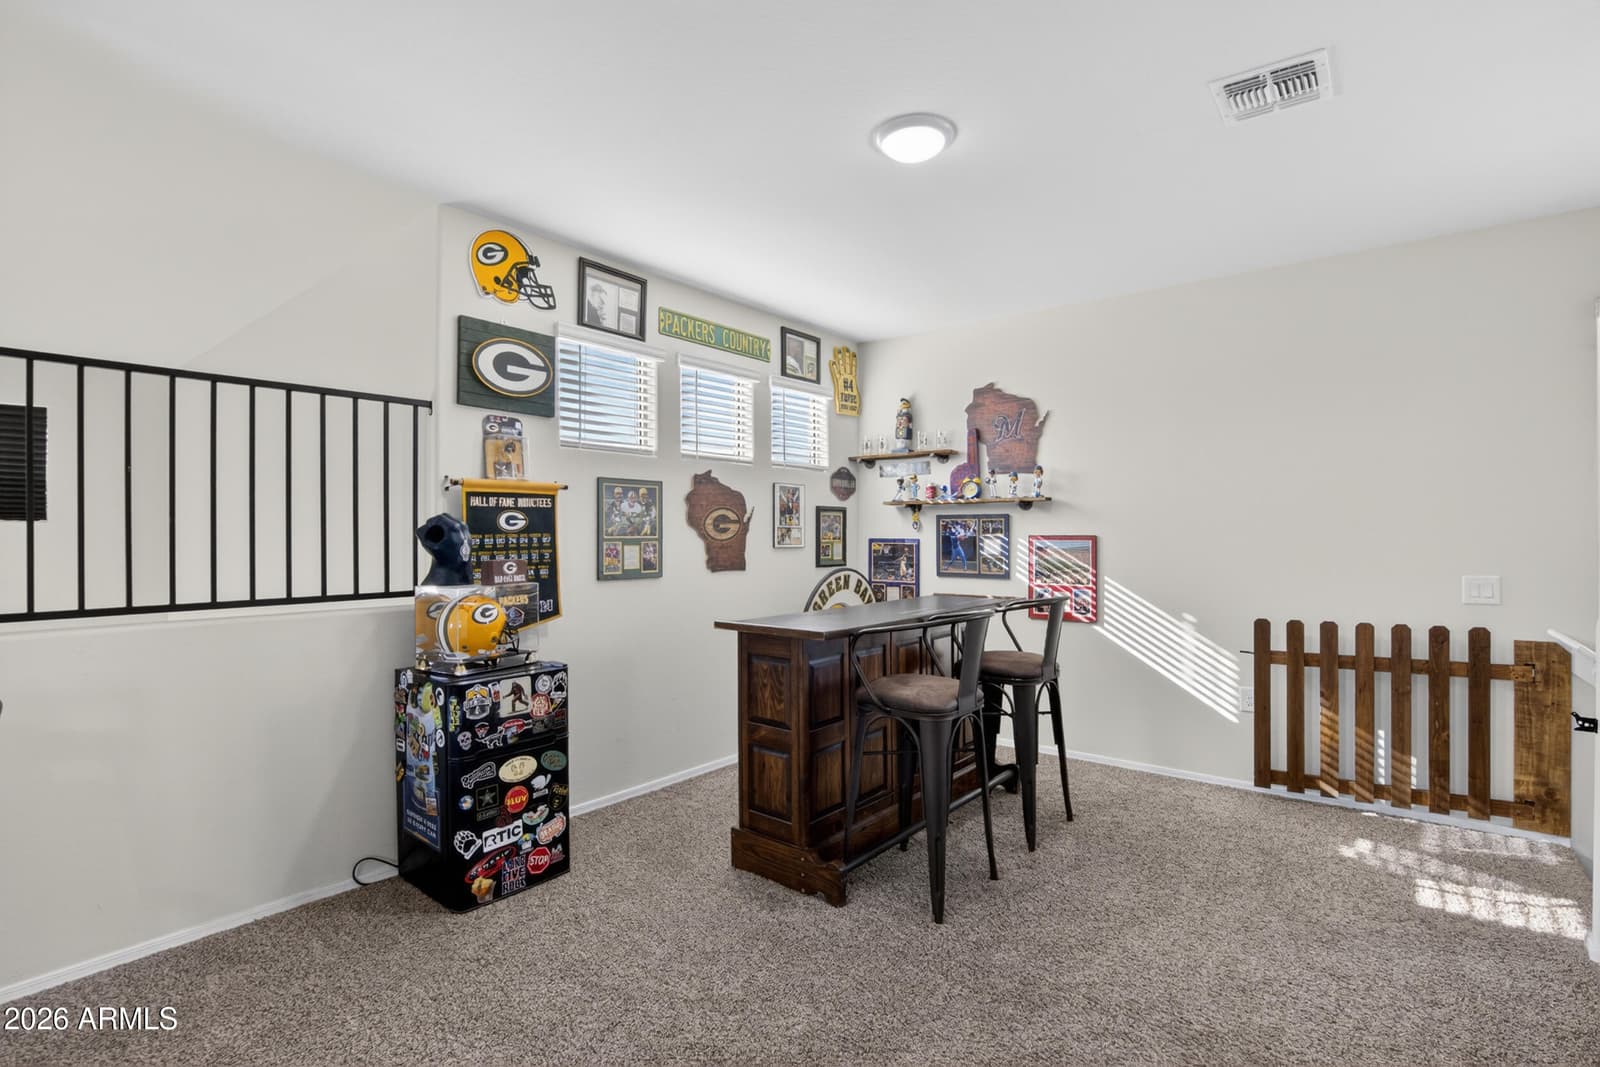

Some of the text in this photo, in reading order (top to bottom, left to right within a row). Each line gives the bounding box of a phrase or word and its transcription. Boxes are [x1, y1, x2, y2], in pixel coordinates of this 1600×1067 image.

[665, 312, 766, 357] PACKERS COUNTRY
[478, 343, 547, 392] G
[470, 496, 488, 507] HALL
[489, 497, 498, 507] OF
[499, 497, 515, 508] FAME
[499, 511, 527, 531] G
[704, 507, 741, 541] G
[812, 574, 850, 611] GREEN
[484, 825, 521, 848] RTIC
[531, 856, 548, 866] STOP
